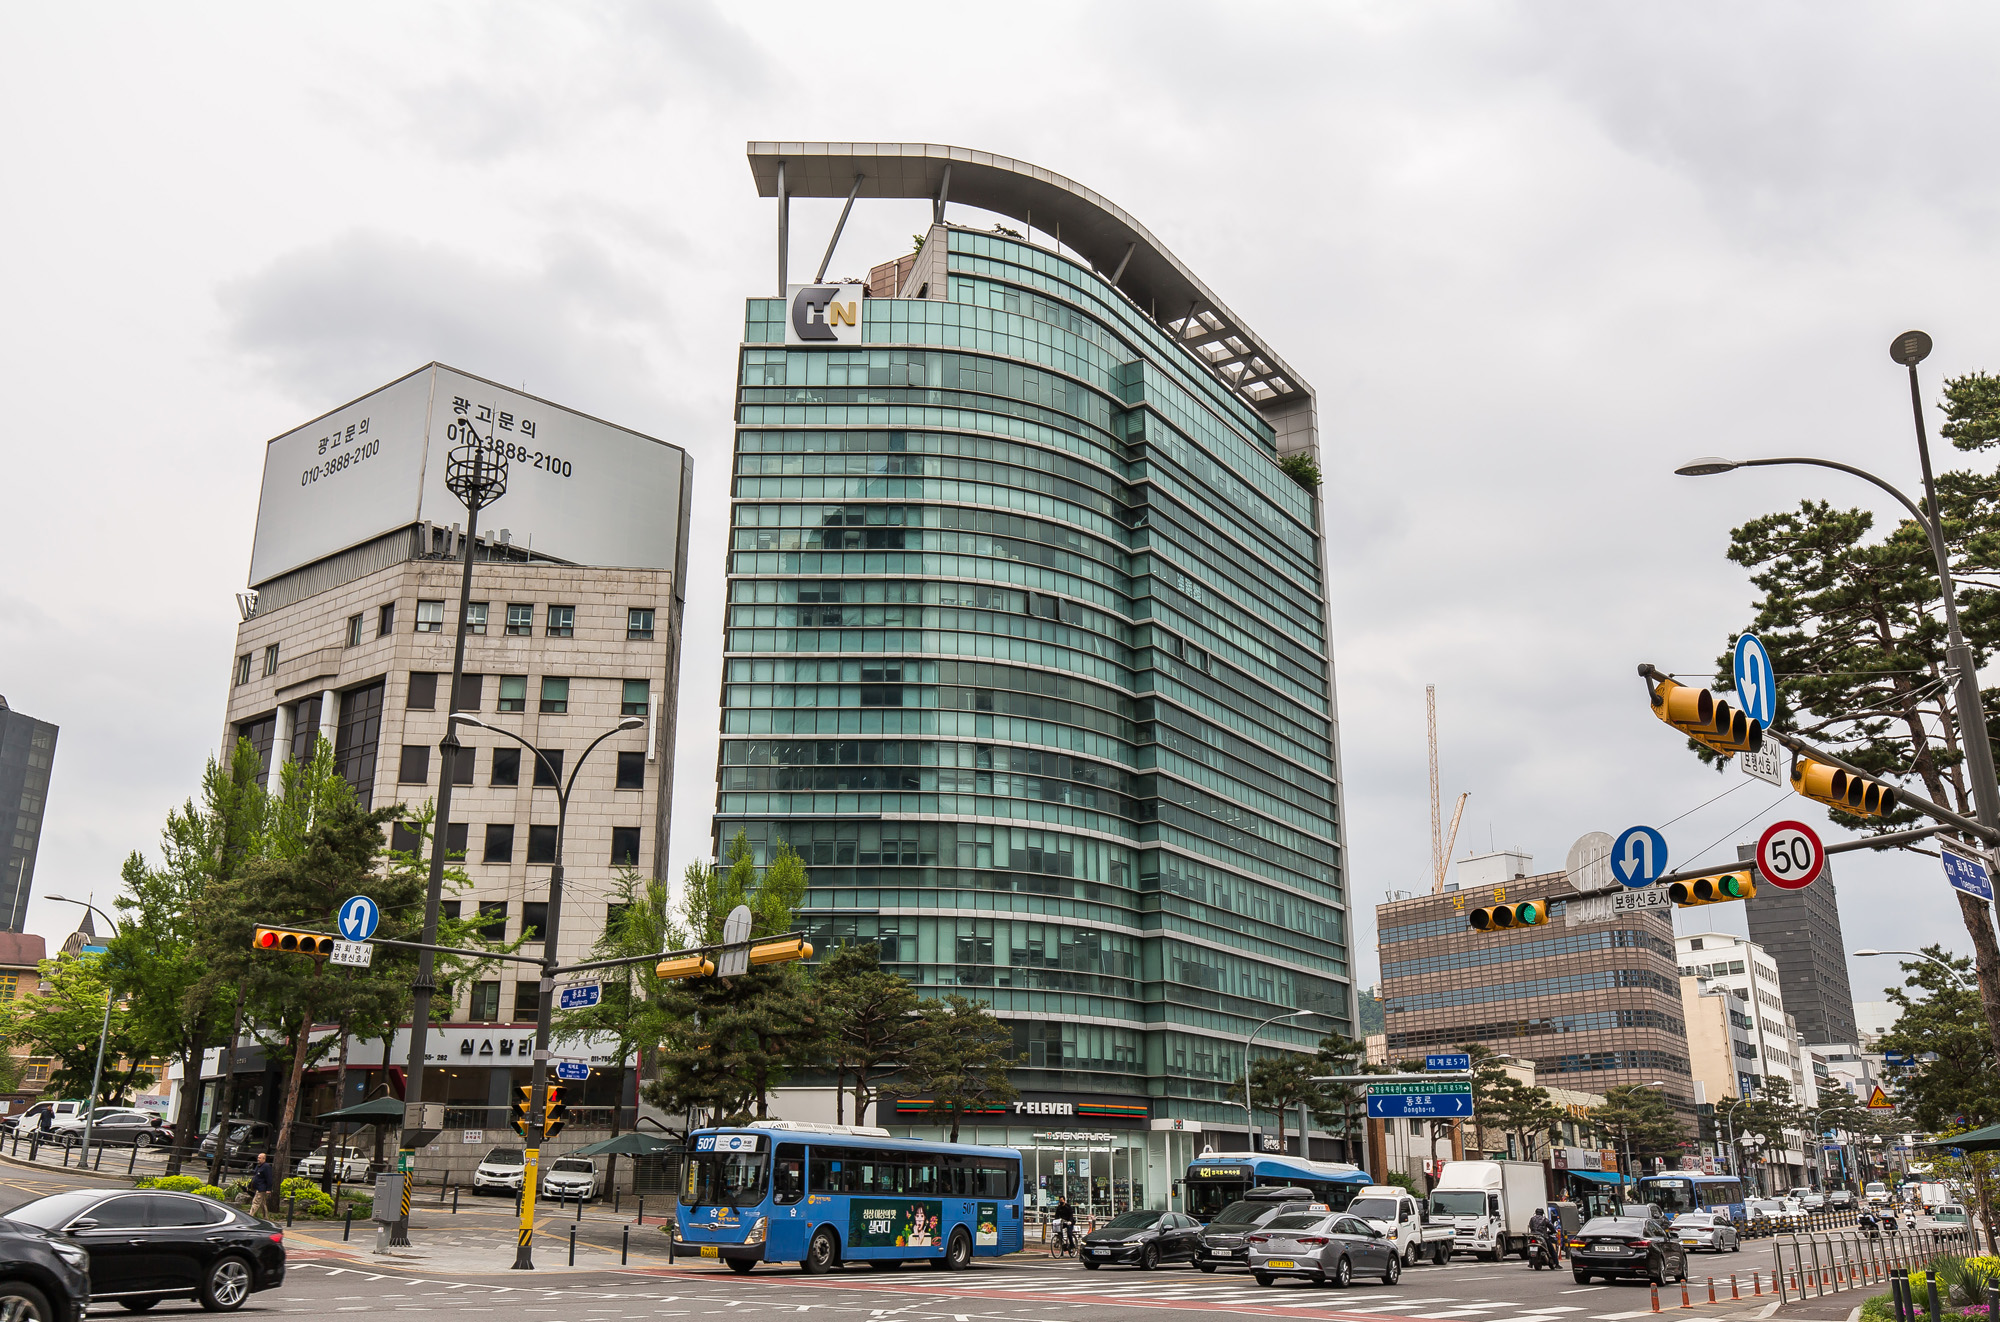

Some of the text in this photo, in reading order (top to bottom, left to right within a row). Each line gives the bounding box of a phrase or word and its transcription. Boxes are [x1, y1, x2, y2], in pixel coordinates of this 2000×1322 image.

[452, 396, 536, 439] 광고문의
[318, 417, 370, 455] 광고문의
[301, 439, 380, 487] 010-3888-2100
[1745, 752, 1779, 779] 보행신호시
[1772, 836, 1811, 874] 50
[1956, 859, 1976, 879] 퇴계로
[1614, 891, 1670, 910] 보행신호시
[334, 943, 372, 955] 좌회전시
[332, 952, 370, 964] 보행신호시
[572, 988, 587, 1000] 동호로
[1428, 1058, 1467, 1067] 퇴계로5가
[1375, 1086, 1400, 1094] 장충체육관
[1437, 1085, 1463, 1093] 을지로5가
[1405, 1096, 1432, 1107] 동호로
[1403, 1106, 1436, 1115] Dongho-ro
[1053, 1132, 1111, 1141] SIGNATURE
[696, 1137, 716, 1150] 507
[1200, 1167, 1211, 1178] 421
[862, 1208, 897, 1220] 상상 이상의 맛
[962, 1202, 975, 1215] 507
[868, 1220, 891, 1234] 샐러디
